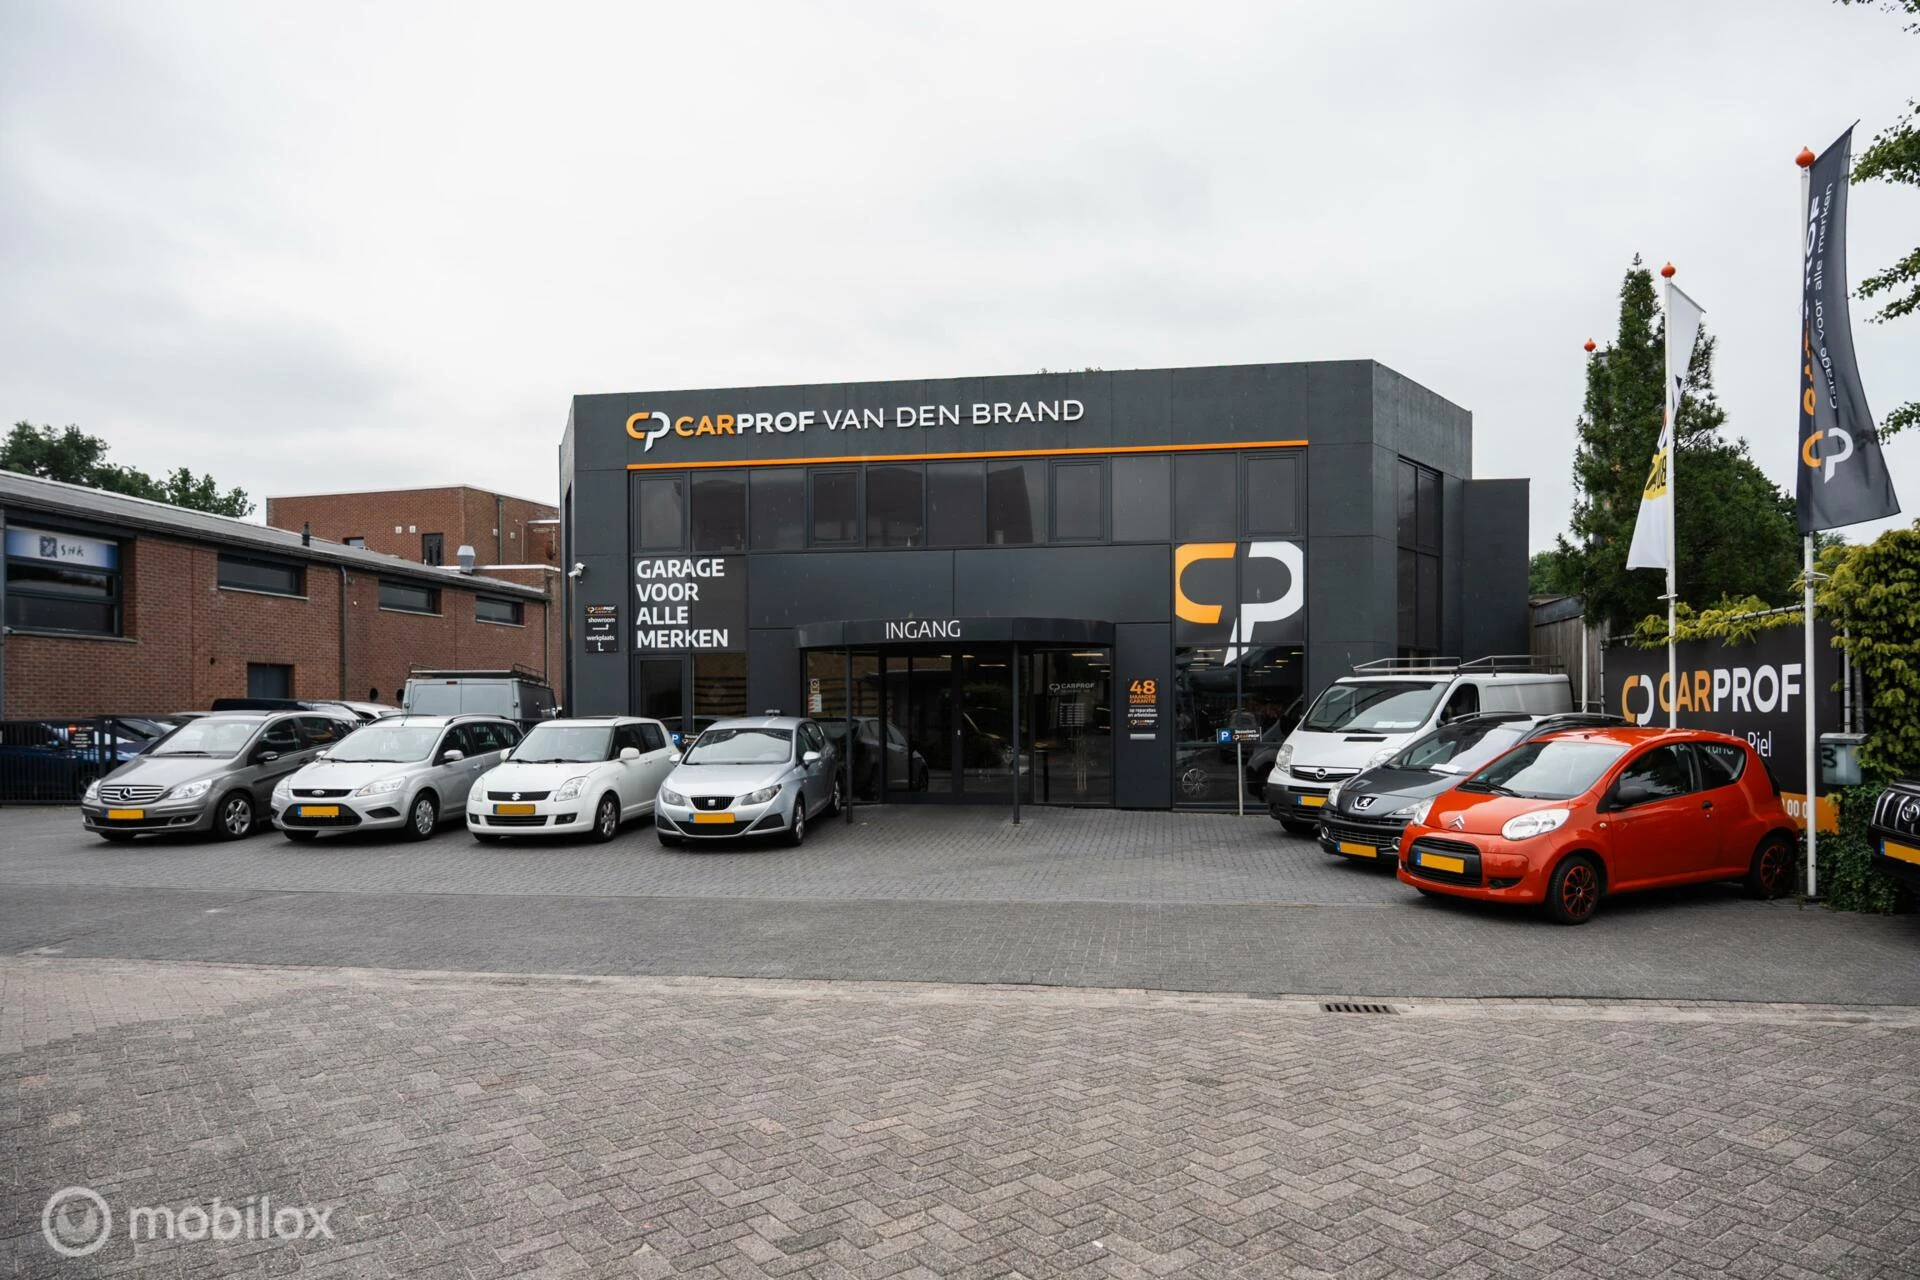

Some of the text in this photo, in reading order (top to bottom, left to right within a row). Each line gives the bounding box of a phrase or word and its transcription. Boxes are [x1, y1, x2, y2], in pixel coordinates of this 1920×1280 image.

[1814, 183, 1838, 409] Garage voor alle merken
[675, 410, 815, 437] CARPROF
[823, 408, 884, 430] VAN
[896, 404, 960, 428] DEN
[972, 399, 1085, 425] BRAND
[636, 559, 725, 579] GARAGE
[636, 583, 700, 602] VOOR
[636, 606, 689, 625] ALLE
[637, 629, 728, 648] MERKEN
[885, 619, 961, 639] INGANG
[1129, 679, 1156, 695] 48
[1659, 663, 1801, 713] CARPROF
[671, 734, 679, 743] P
[1221, 731, 1229, 741] P
[1747, 730, 1772, 757] Riel
[1787, 799, 1799, 818] 00
